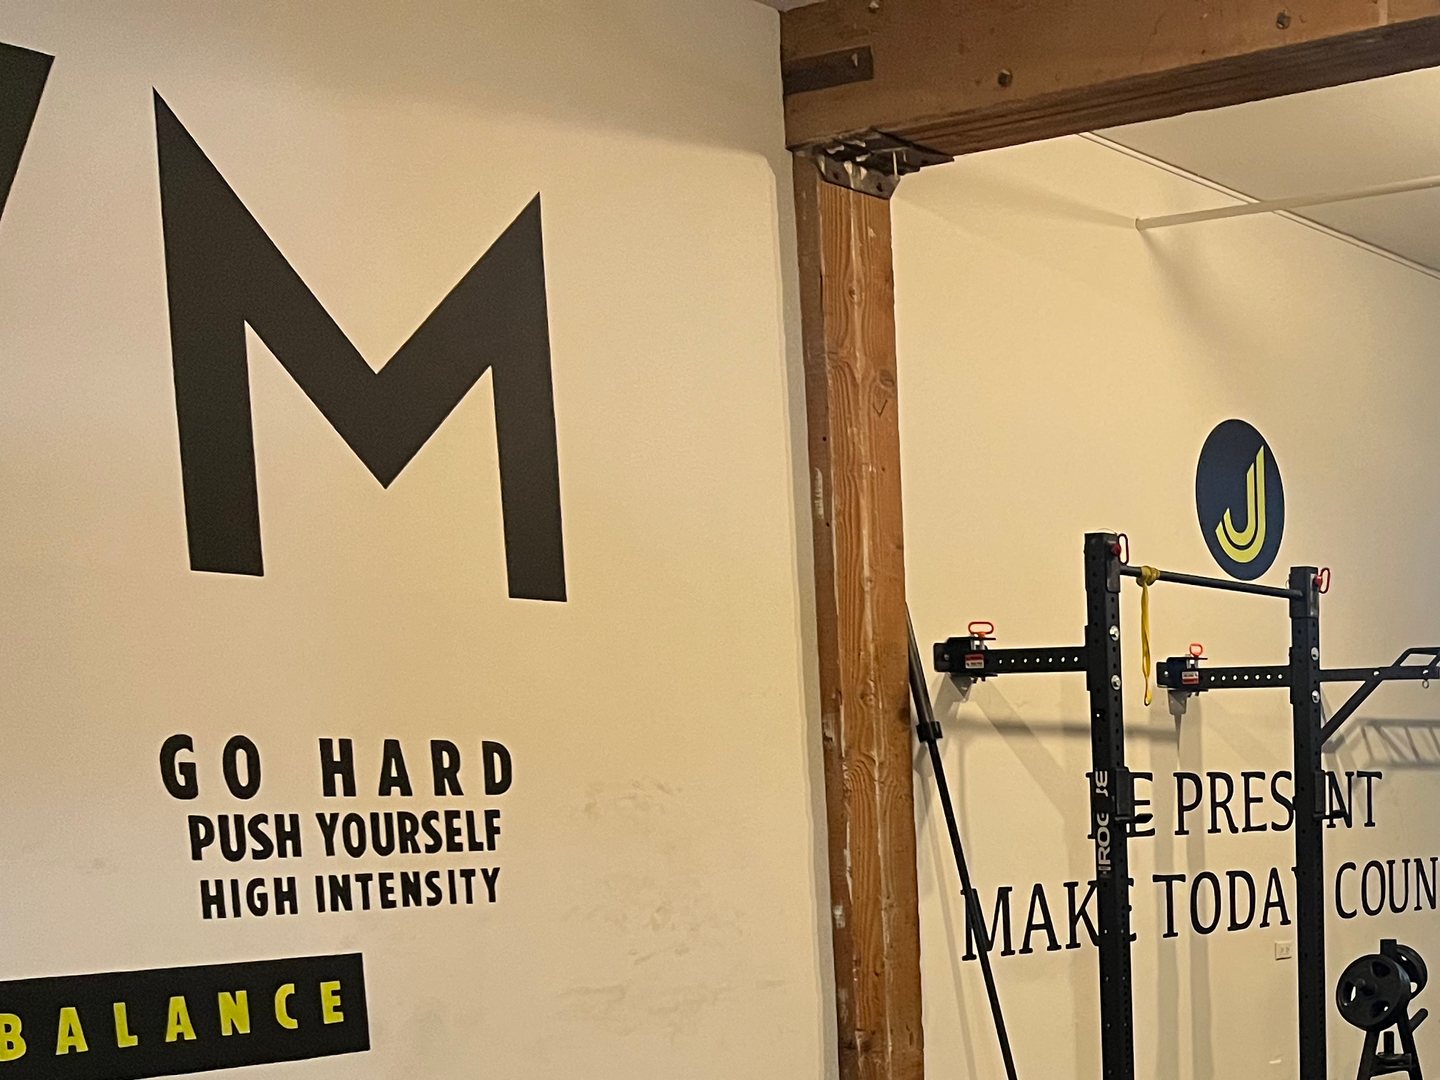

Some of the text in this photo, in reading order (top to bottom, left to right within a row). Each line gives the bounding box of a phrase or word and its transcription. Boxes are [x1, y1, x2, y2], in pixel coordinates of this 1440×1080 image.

[0, 42, 567, 603] M
[159, 734, 513, 800] GO HARD
[188, 809, 501, 862] PUSH YOURSELF
[1173, 770, 1383, 836] PRESNT
[200, 867, 501, 919] HIGH INTENSITY
[960, 881, 1134, 961] MAK
[1152, 866, 1299, 938] TODA
[0, 980, 345, 1063] BALANCE
